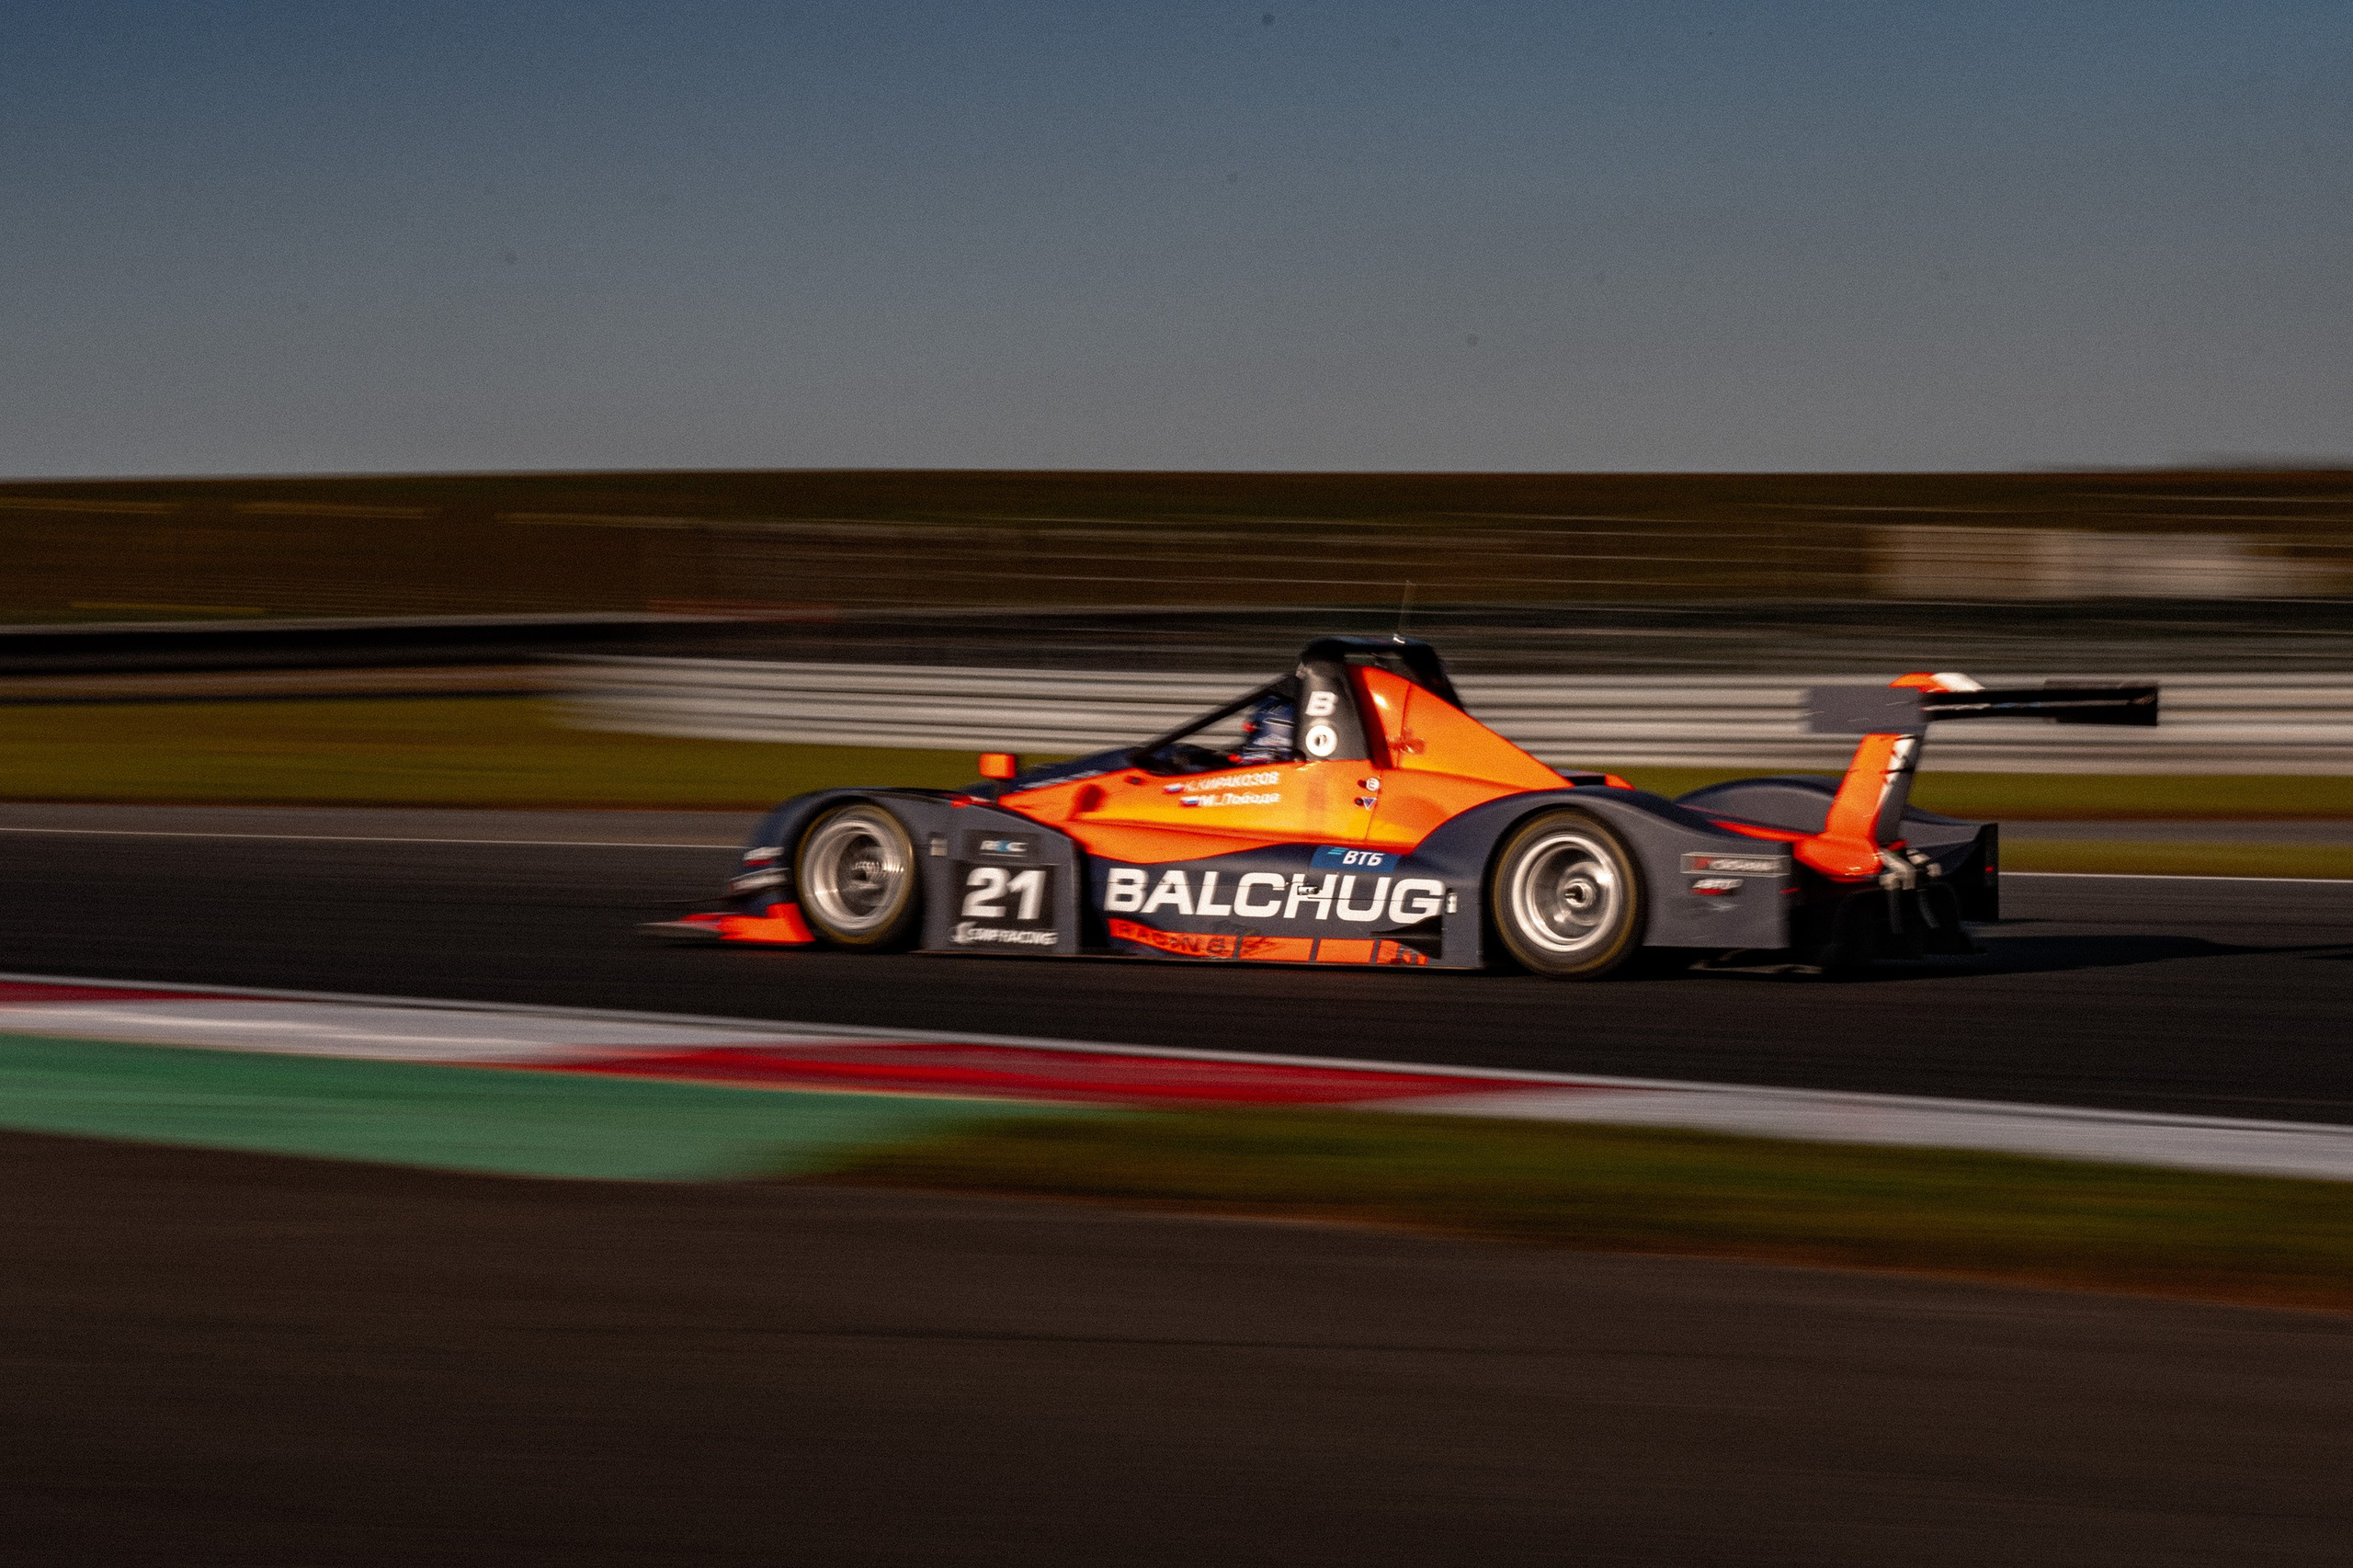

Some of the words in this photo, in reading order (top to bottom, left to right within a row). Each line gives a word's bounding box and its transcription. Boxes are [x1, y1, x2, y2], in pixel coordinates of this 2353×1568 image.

[1305, 691, 1338, 716] B
[1342, 850, 1384, 866] ВТБ
[961, 867, 1047, 919] 21
[1104, 868, 1446, 924] BALCHUG
